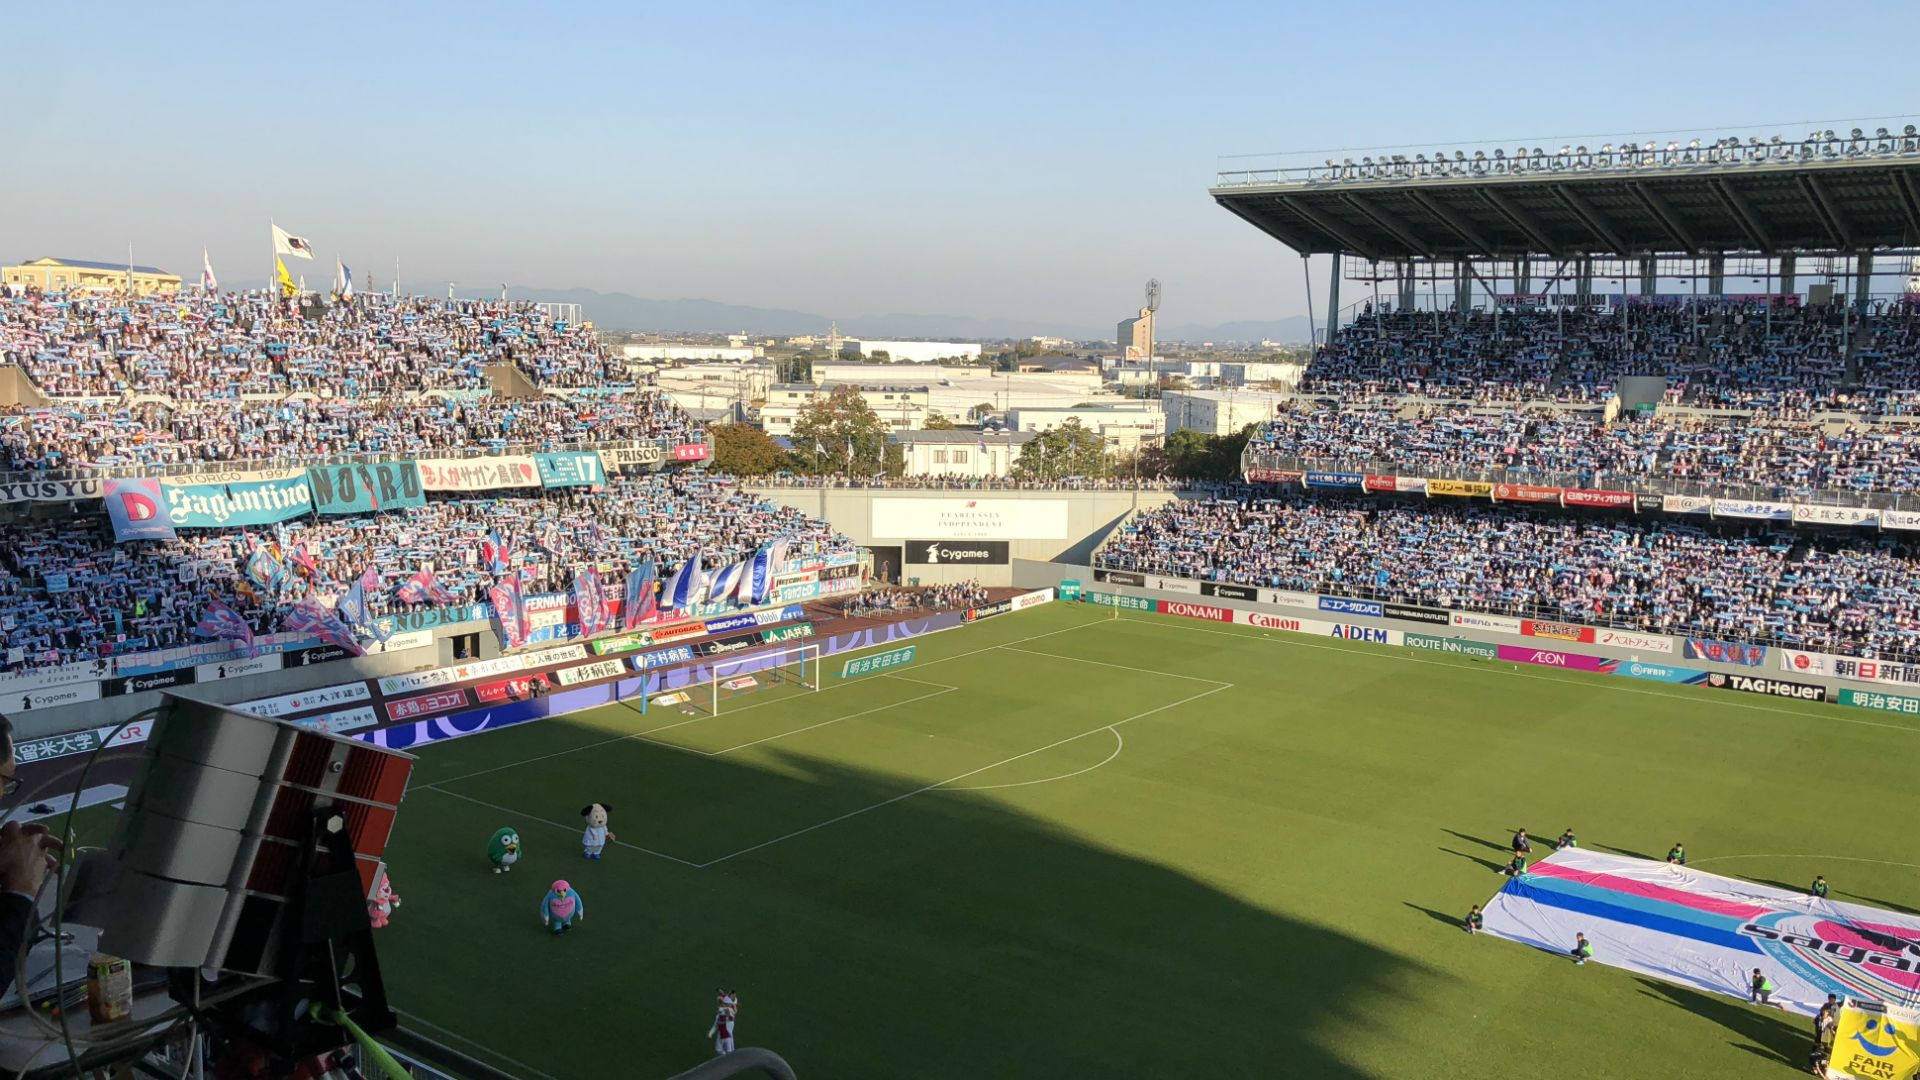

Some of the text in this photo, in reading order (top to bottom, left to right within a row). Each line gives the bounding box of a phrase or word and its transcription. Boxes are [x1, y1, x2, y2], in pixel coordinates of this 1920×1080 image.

[617, 449, 658, 462] PRISCO
[175, 469, 291, 485] STORICO 1997
[168, 483, 310, 523] Sagantino
[941, 549, 989, 560] Cygames
[1020, 594, 1046, 607] docomo
[1093, 593, 1149, 609] 明治安田生命
[756, 611, 778, 624] Obbli
[1167, 602, 1222, 621] KONAMI
[1248, 612, 1300, 631] Canon
[664, 624, 703, 637] AUTOBACS
[388, 637, 418, 649] Cygames
[1407, 637, 1440, 650] ROUTE
[1463, 647, 1495, 657] HOTELS
[1613, 636, 1670, 651] ベストアメニティ
[311, 649, 344, 661] Cygames
[537, 650, 577, 664] 人権の世紀
[645, 648, 691, 666] 今村病院
[850, 650, 913, 674] 明治安田生命
[228, 662, 263, 673] Cygames
[135, 676, 175, 688] Cygames
[35, 691, 77, 704] Cygames
[120, 727, 142, 740] JR
[1853, 1053, 1894, 1072] FAIR
[1849, 1060, 1896, 1080] PLAY
